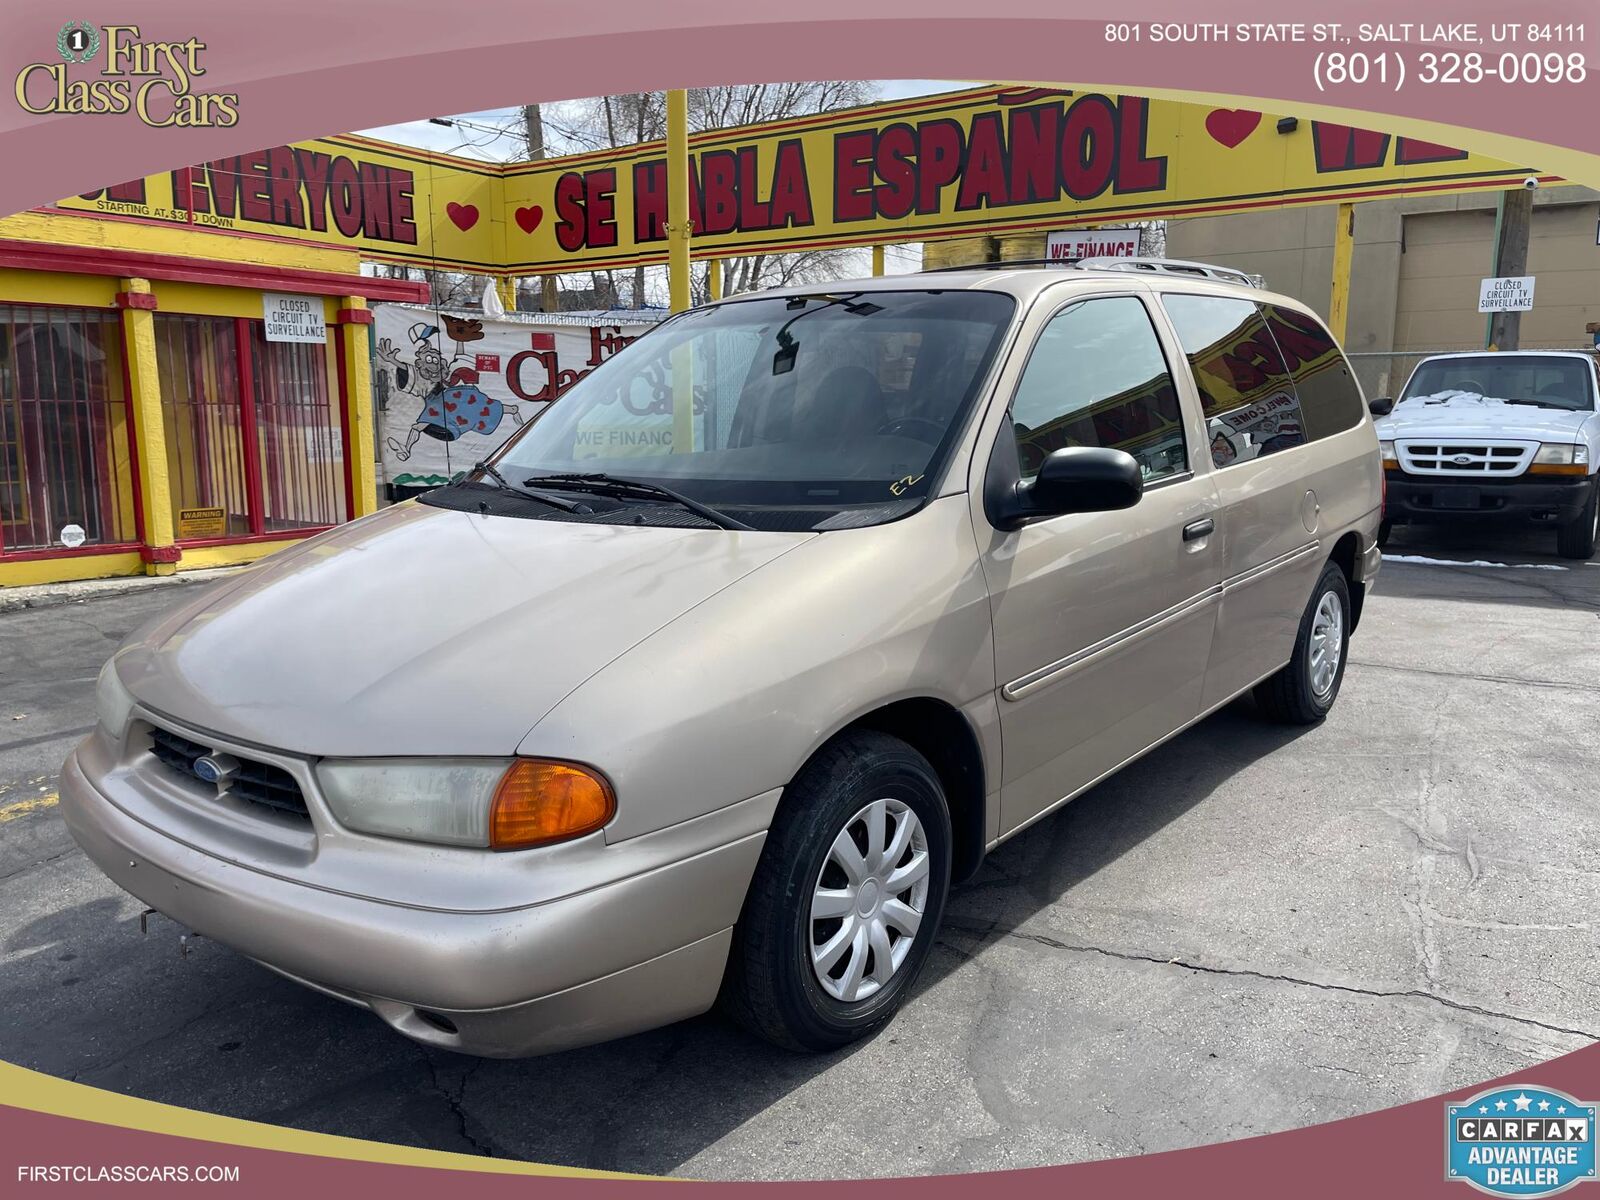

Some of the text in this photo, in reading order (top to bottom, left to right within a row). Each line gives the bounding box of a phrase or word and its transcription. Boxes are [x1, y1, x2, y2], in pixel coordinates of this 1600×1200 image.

[97, 200, 149, 215] STARTING
[202, 214, 234, 228] DOWN
[555, 167, 618, 252] SE
[1051, 241, 1135, 264] WE FINANCE
[1494, 280, 1522, 290] CLOSED
[1486, 289, 1528, 299] CIRCUIT TV
[279, 299, 310, 313] CLOSED
[1480, 297, 1532, 308] SURVEILLANCE
[272, 311, 318, 325] CIRCUIT TV
[267, 323, 326, 338] SURVEILLANCE
[576, 431, 673, 445] WE FINANC
[183, 510, 222, 519] WARNING
